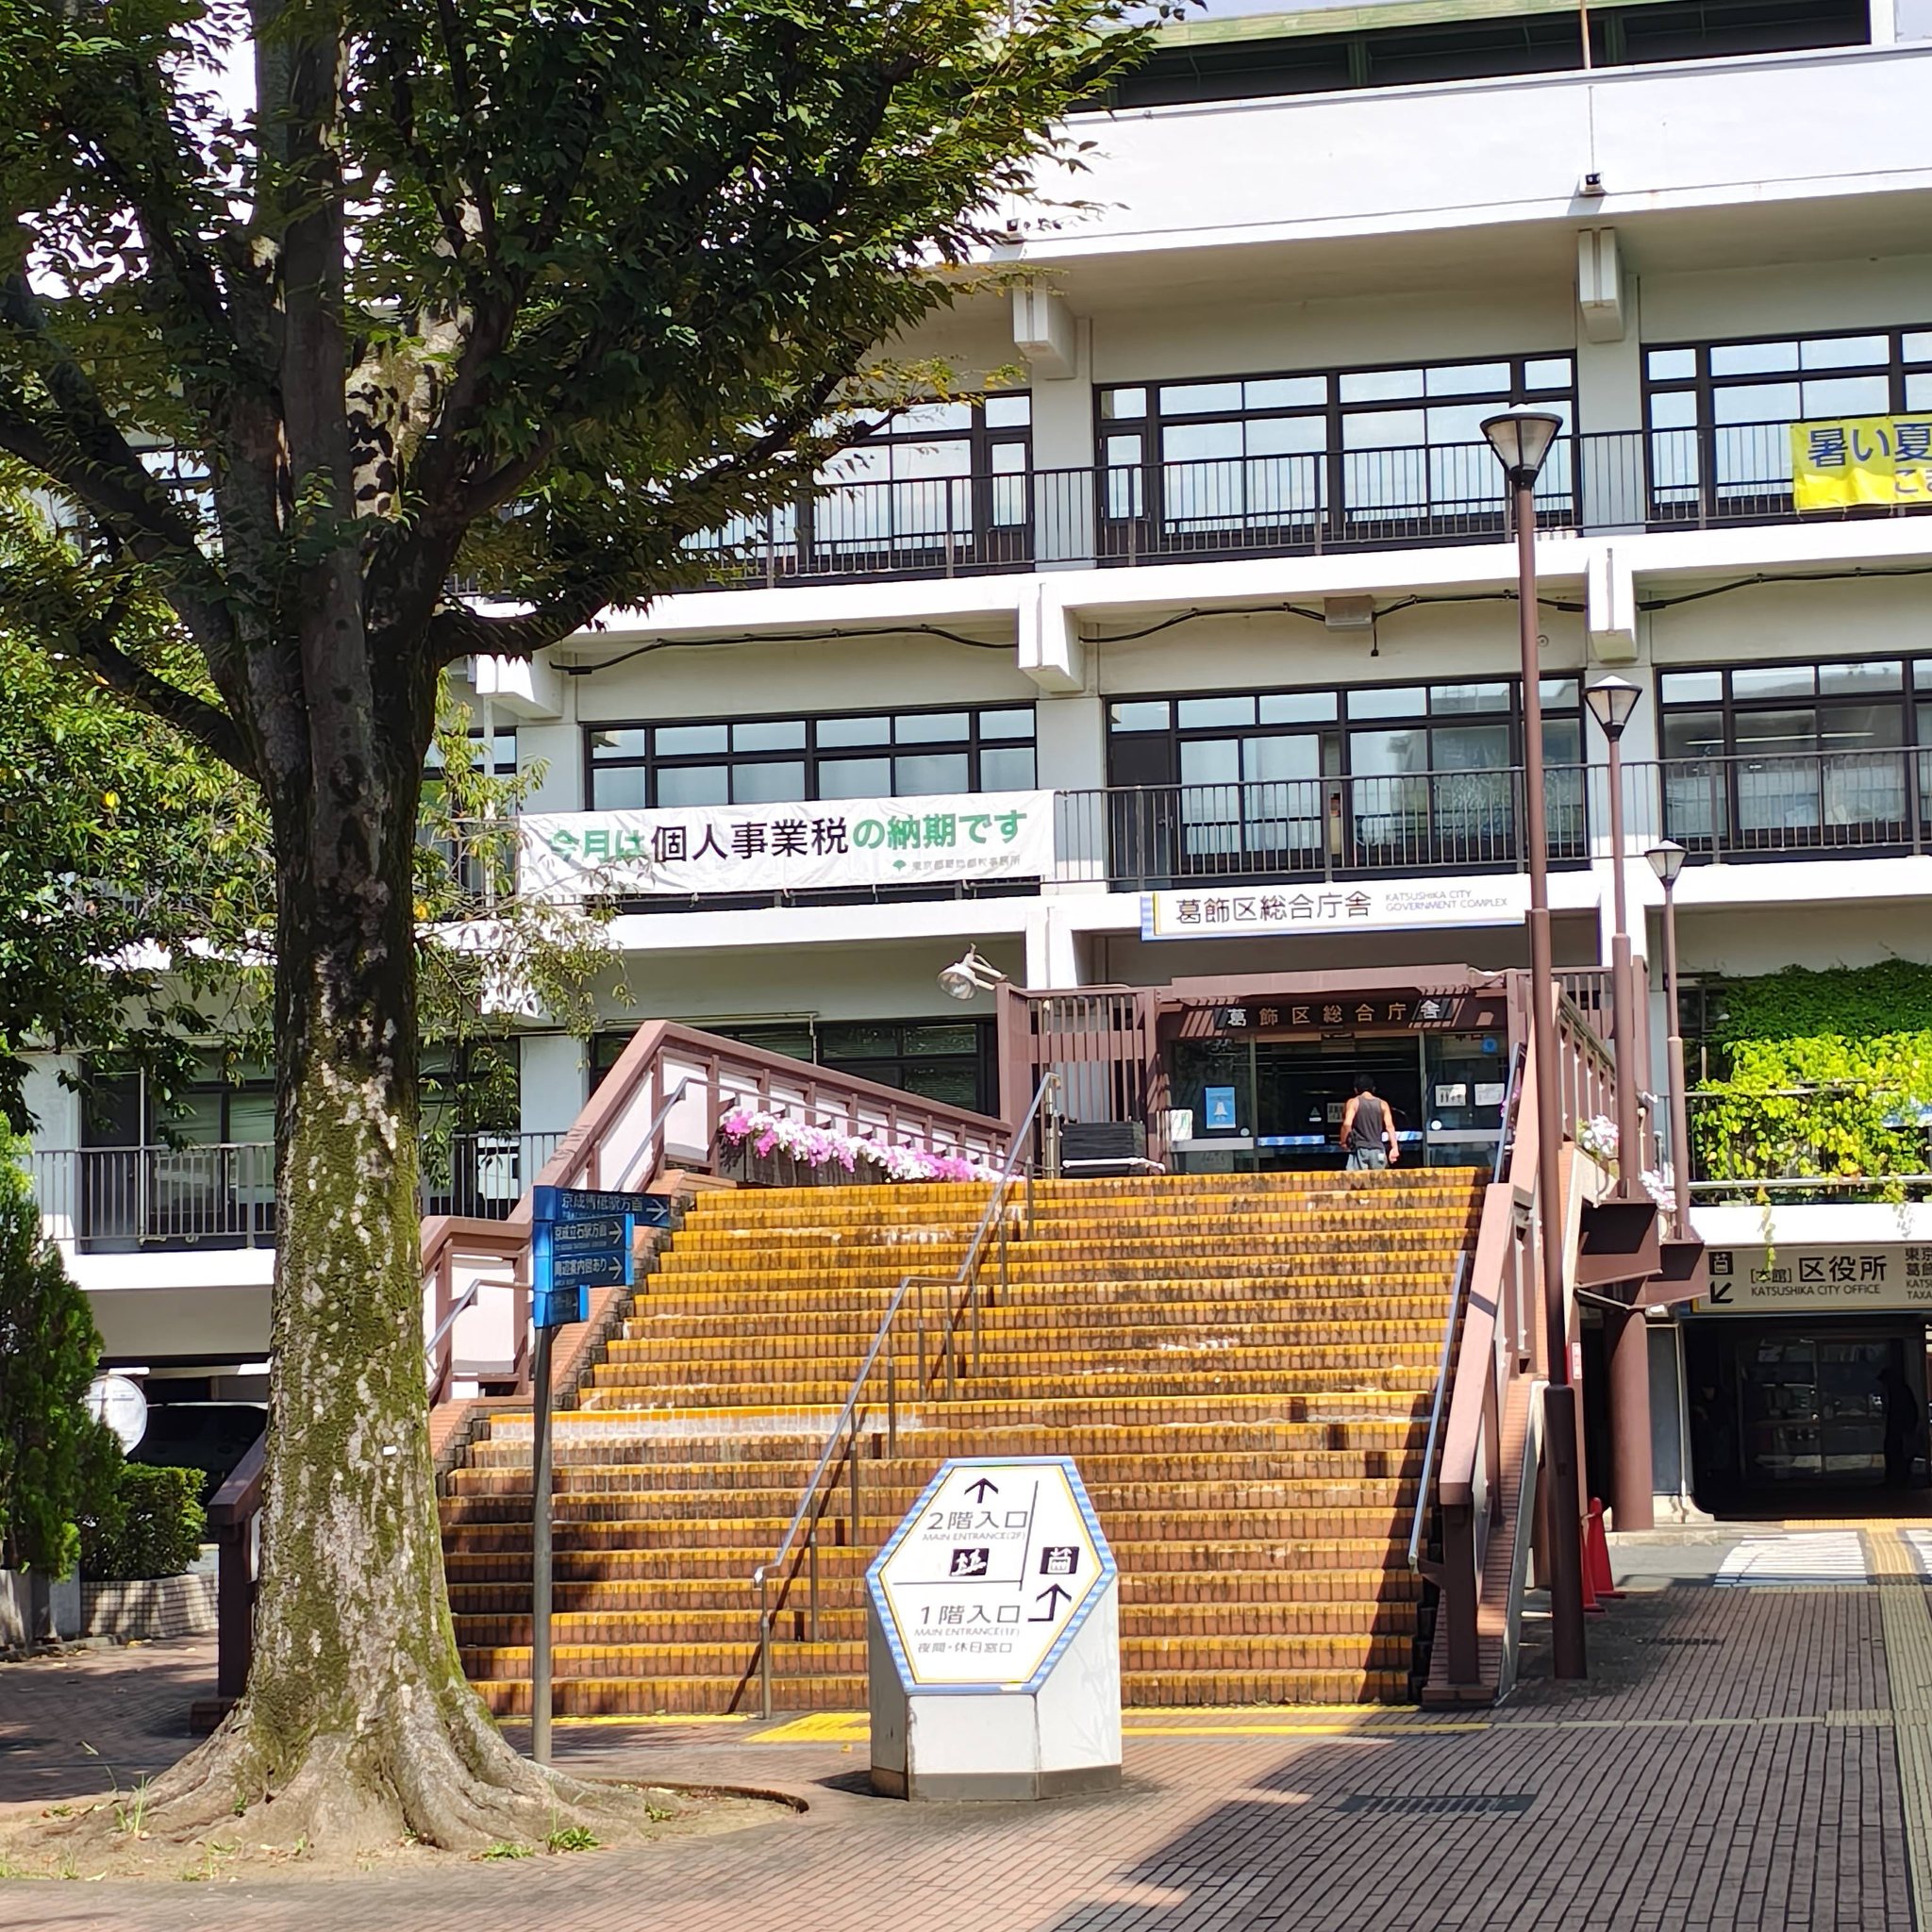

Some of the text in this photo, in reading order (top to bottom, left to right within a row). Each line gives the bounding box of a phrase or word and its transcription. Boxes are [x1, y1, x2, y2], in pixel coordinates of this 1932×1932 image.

[1808, 423, 1932, 467] 暑い夏
[1385, 890, 1472, 902] KATSUSHIKA CITY
[1386, 898, 1507, 911] GOVERNMENT COMPLEX
[1175, 891, 1372, 924] 葛飾区総合庁舎
[1227, 1000, 1441, 1027] 葛飾区総合庁舎
[1799, 1256, 1887, 1282] 区役所
[1751, 1284, 1880, 1296] KATSUSHIKA CITY OFFICE
[926, 1511, 1028, 1530] 2階入口
[923, 1533, 950, 1541] MAIN
[921, 1605, 1021, 1624] 1階入口
[914, 1628, 942, 1637] MAIN
